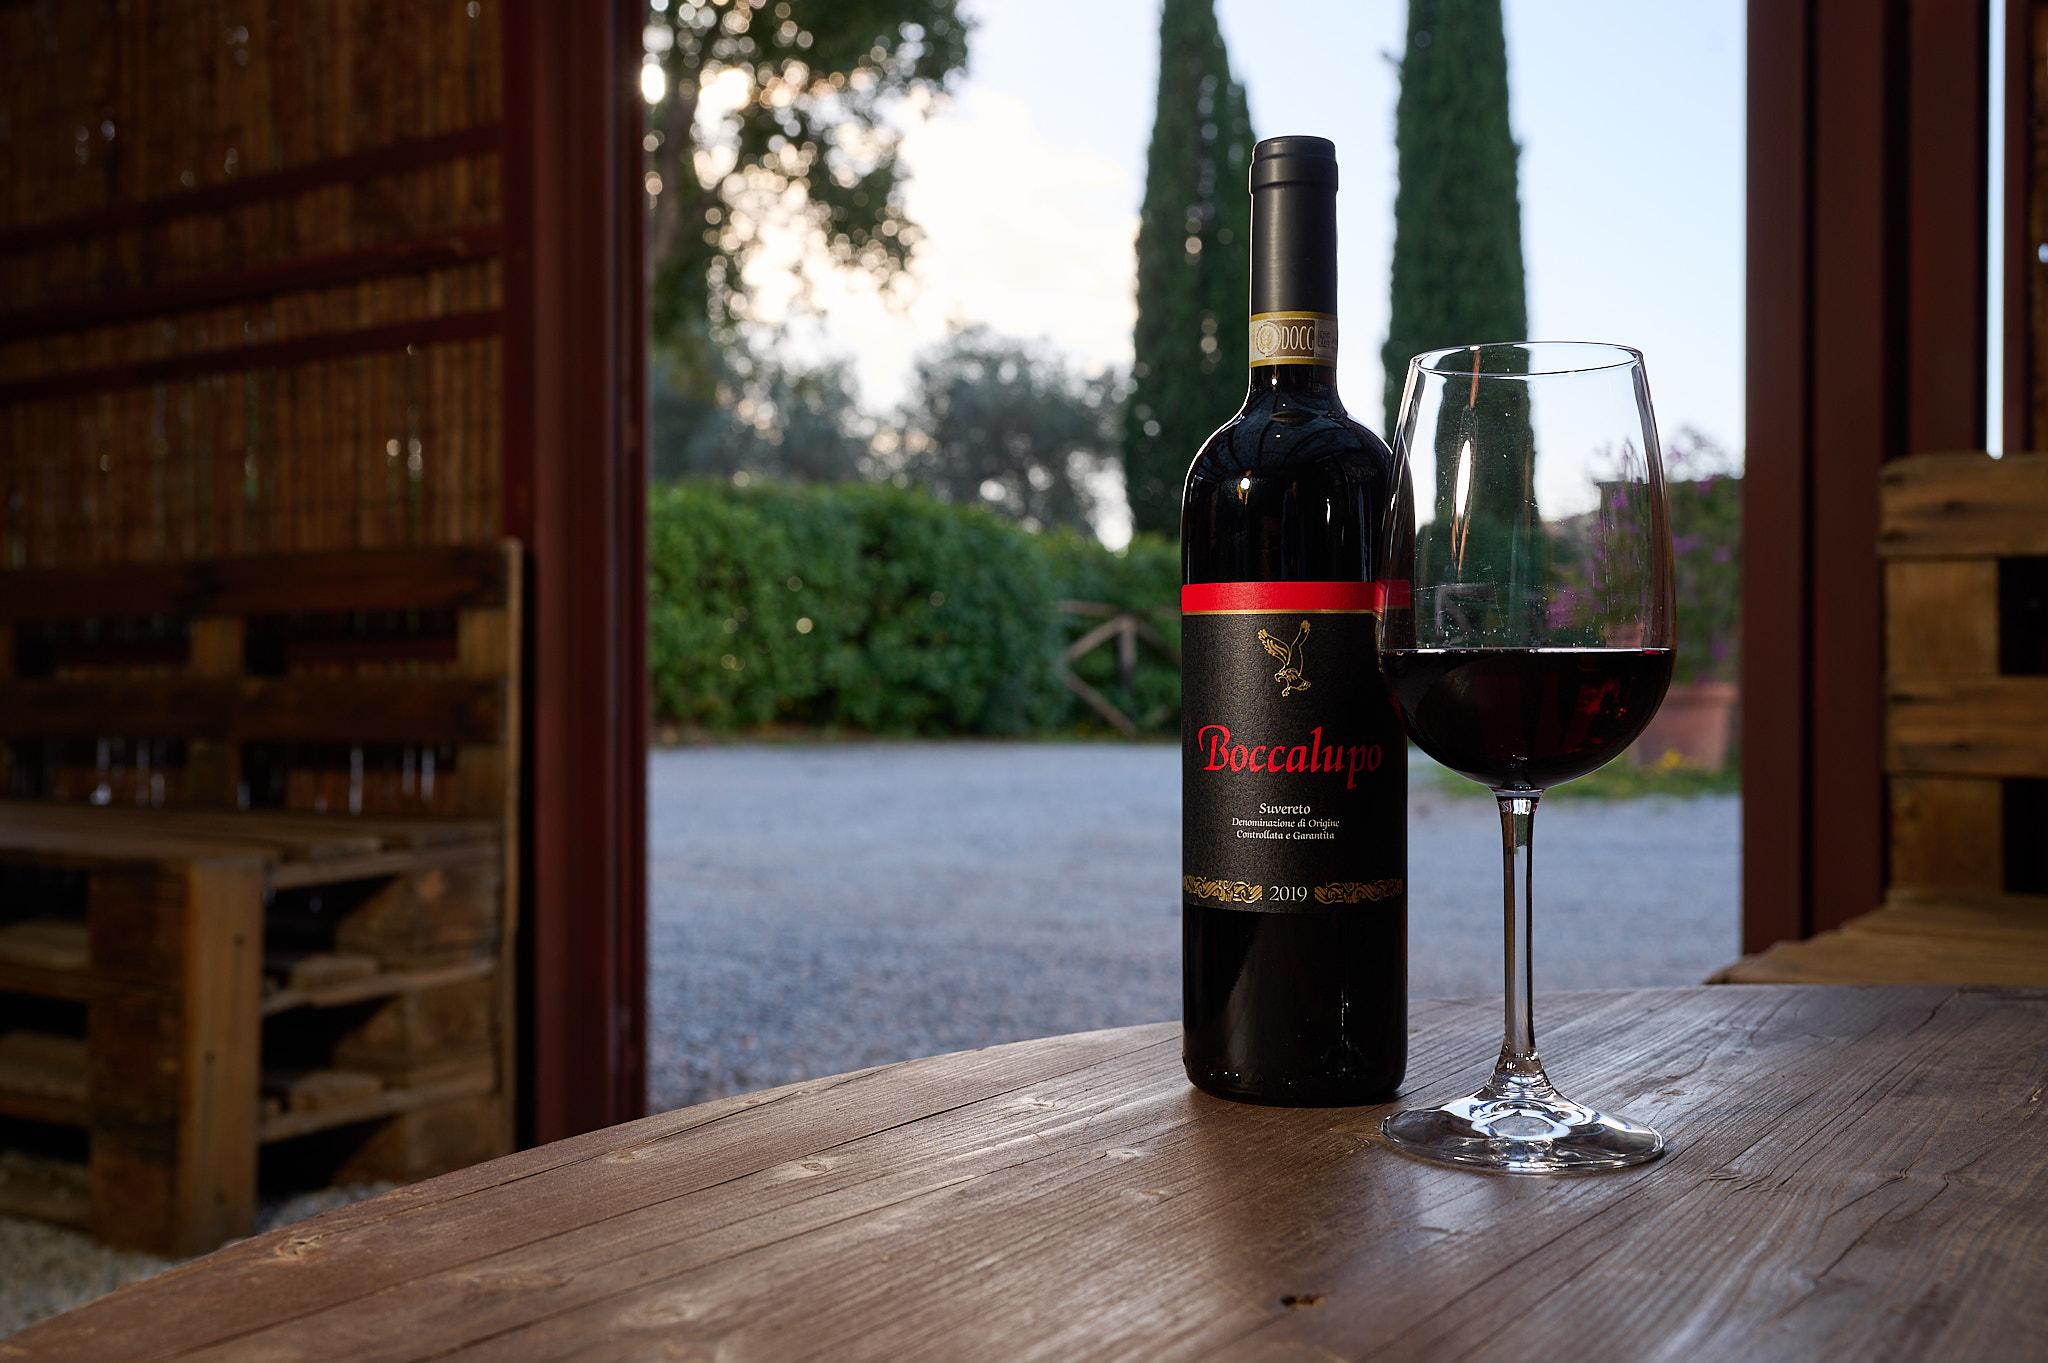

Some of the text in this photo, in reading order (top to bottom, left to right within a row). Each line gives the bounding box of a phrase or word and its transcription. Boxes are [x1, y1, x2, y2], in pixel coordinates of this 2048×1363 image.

[1198, 724, 1383, 790] Boccalupo
[1259, 803, 1311, 815] Suvereto
[1231, 817, 1340, 831] Denominazione di Origine
[1236, 829, 1335, 840] Controllata e Garantita
[1268, 885, 1308, 902] 2019
